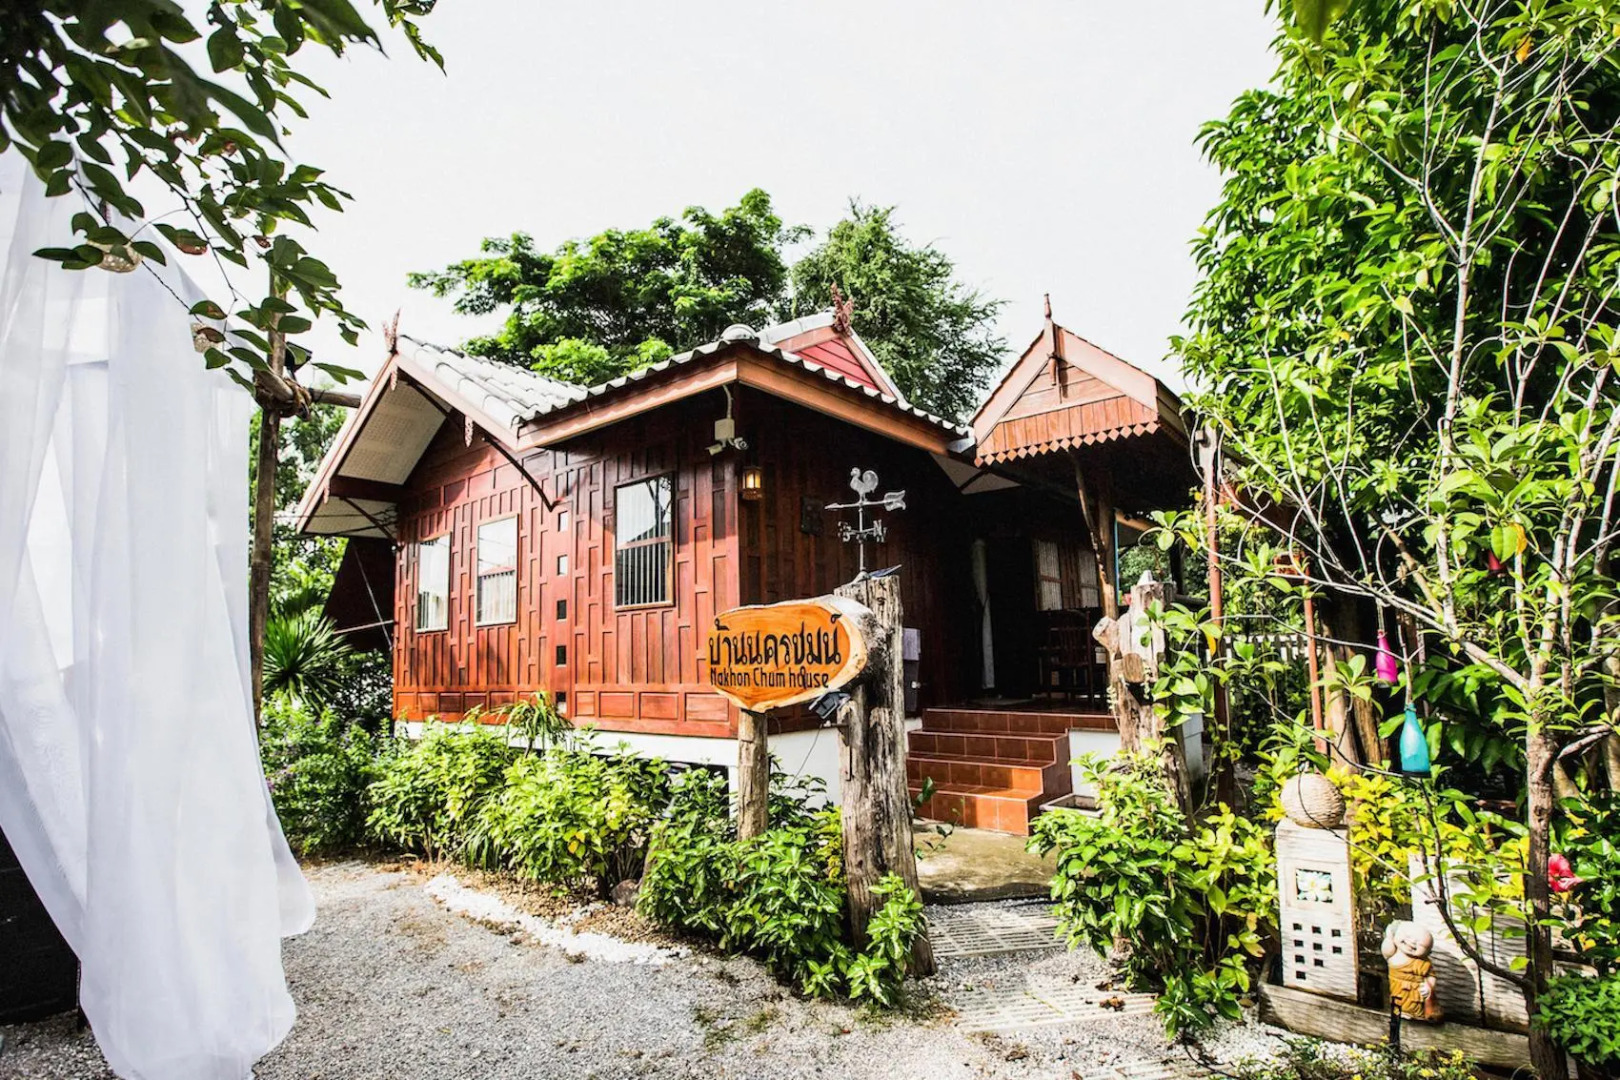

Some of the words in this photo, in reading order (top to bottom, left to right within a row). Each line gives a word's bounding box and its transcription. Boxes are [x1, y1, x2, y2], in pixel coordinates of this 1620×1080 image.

[710, 667, 750, 687] Nakhon
[753, 667, 786, 688] Chum
[788, 667, 829, 688] house
